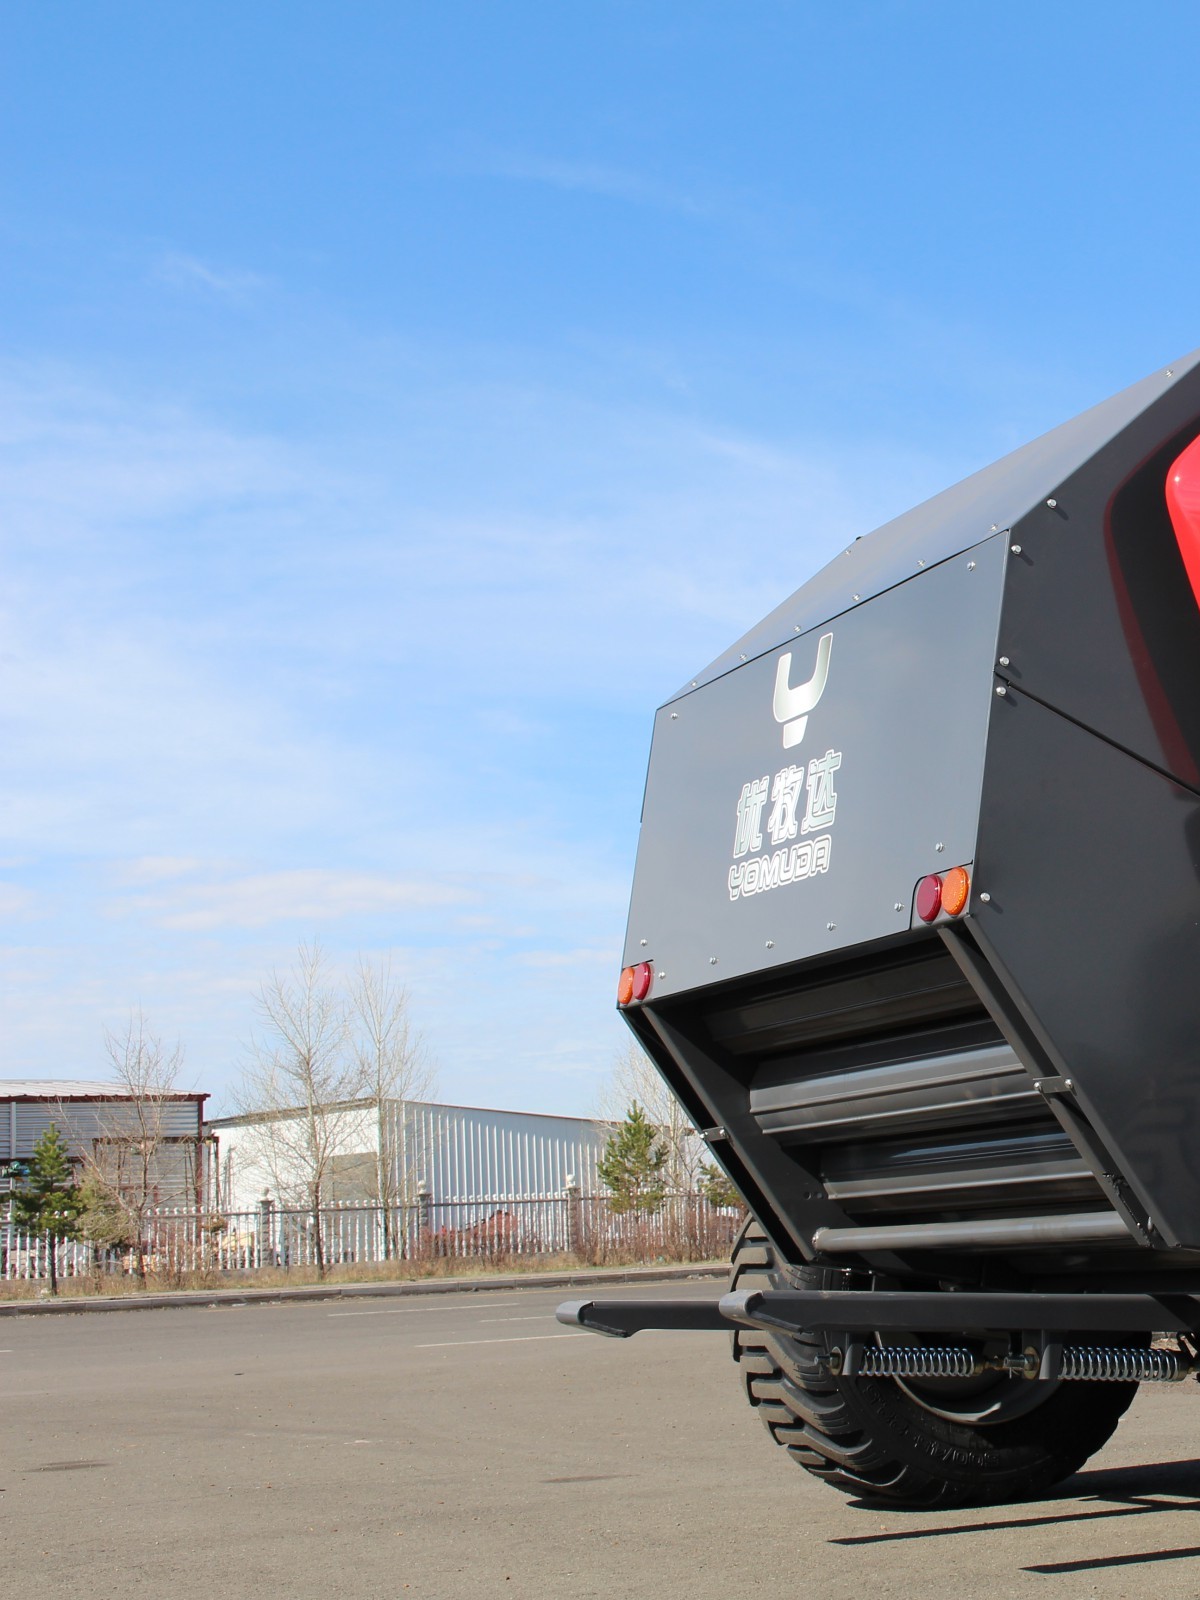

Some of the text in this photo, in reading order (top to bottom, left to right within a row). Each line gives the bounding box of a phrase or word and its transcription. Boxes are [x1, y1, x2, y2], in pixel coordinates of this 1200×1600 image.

[733, 749, 842, 858] 优牧达
[728, 834, 831, 901] YOMUDA
